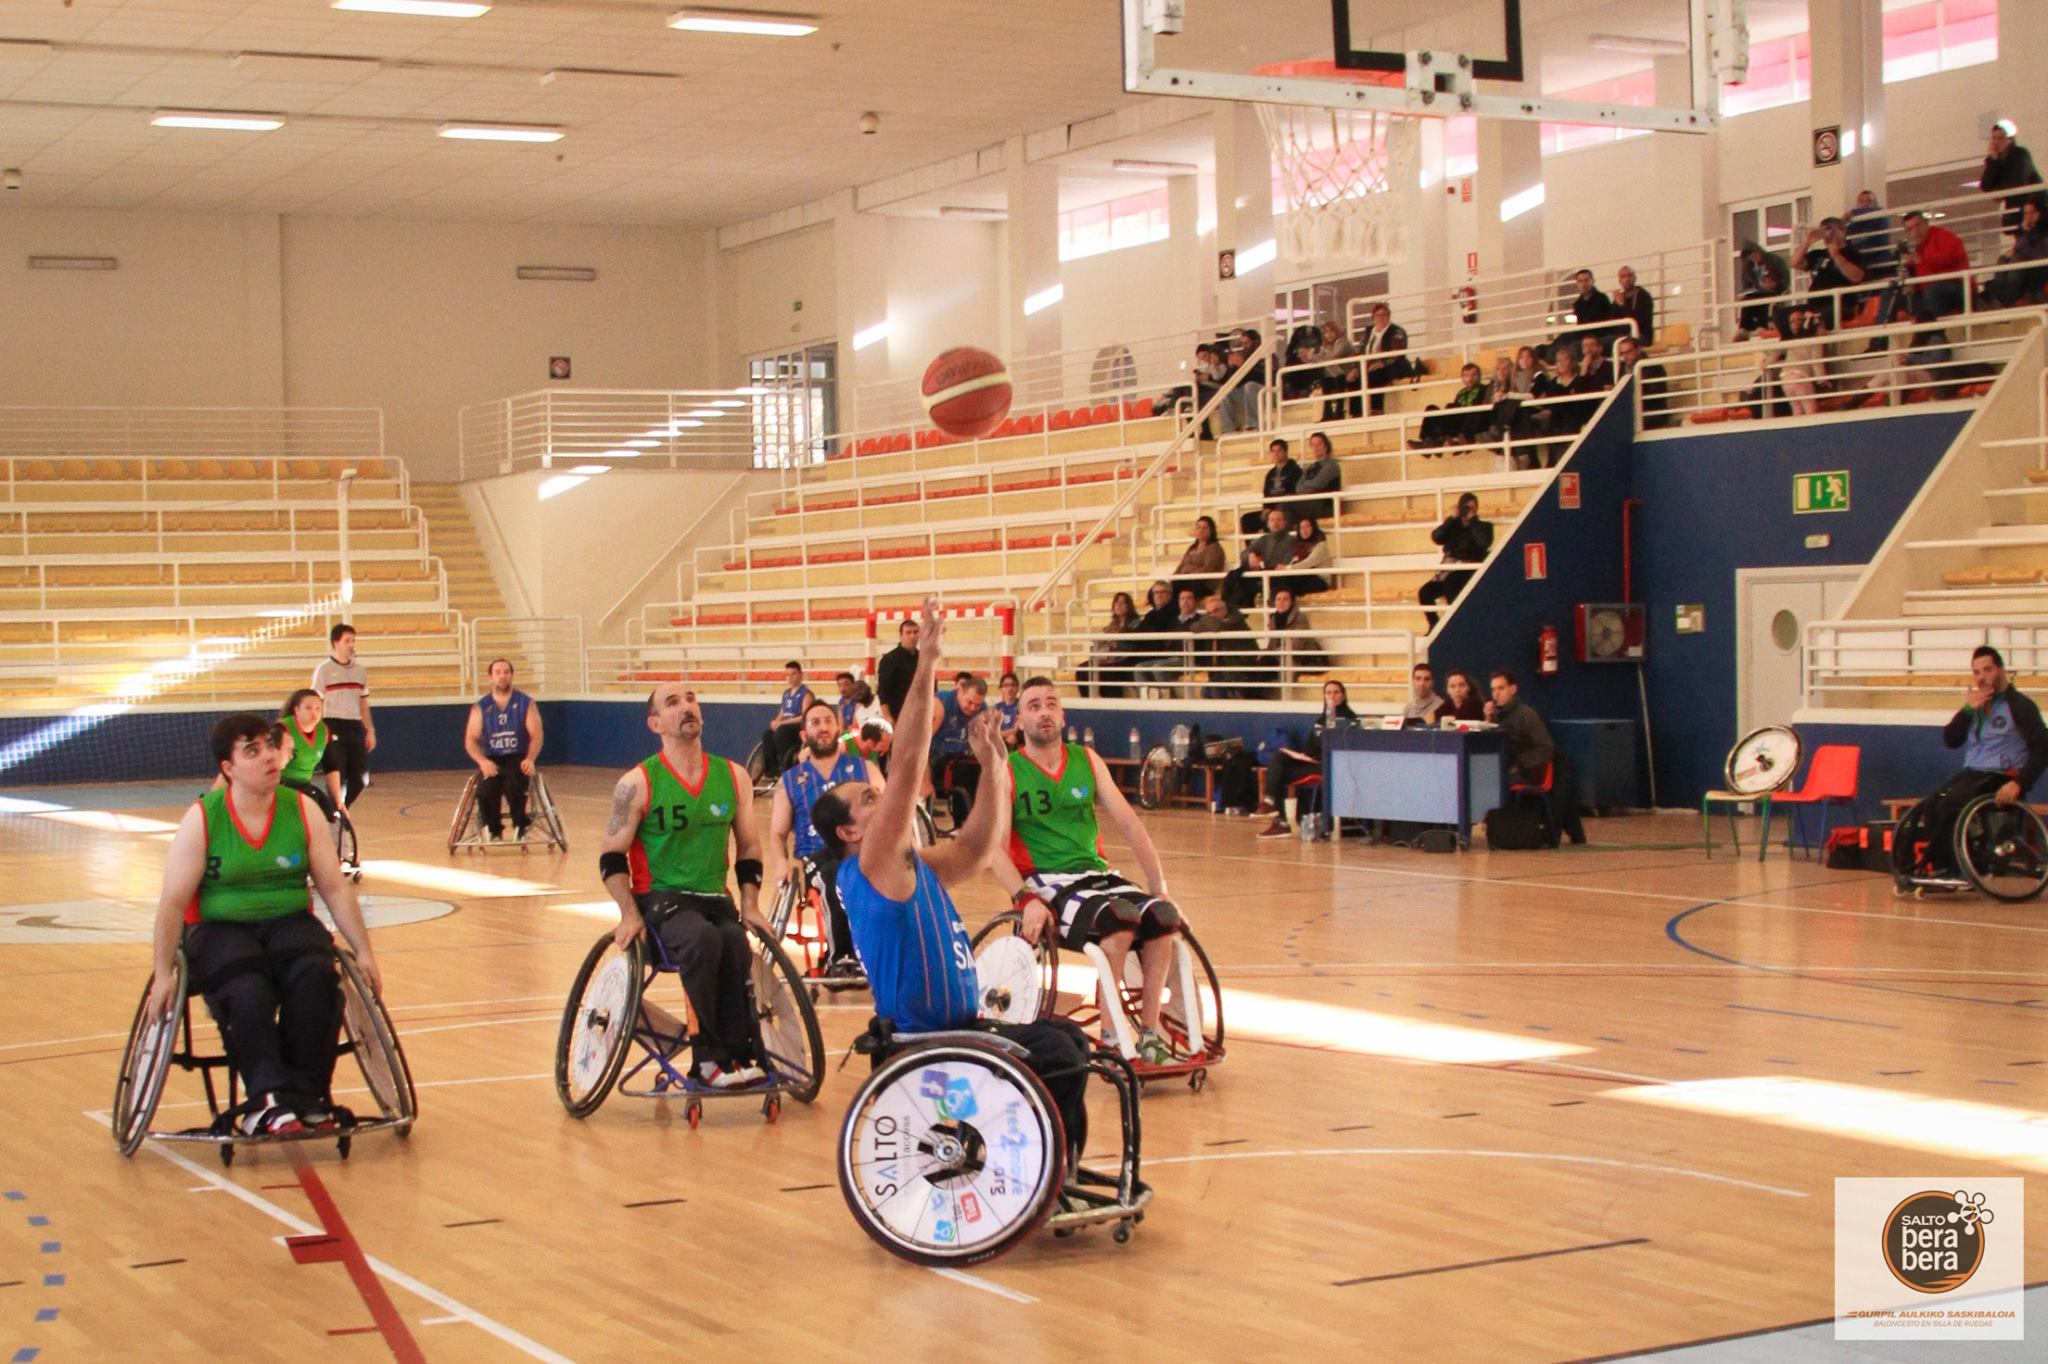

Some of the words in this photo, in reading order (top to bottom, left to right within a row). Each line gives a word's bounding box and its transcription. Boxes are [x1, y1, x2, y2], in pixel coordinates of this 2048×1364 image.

[1020, 790, 1052, 816] 13
[653, 804, 688, 832] 15
[875, 1116, 897, 1197] SALTO
